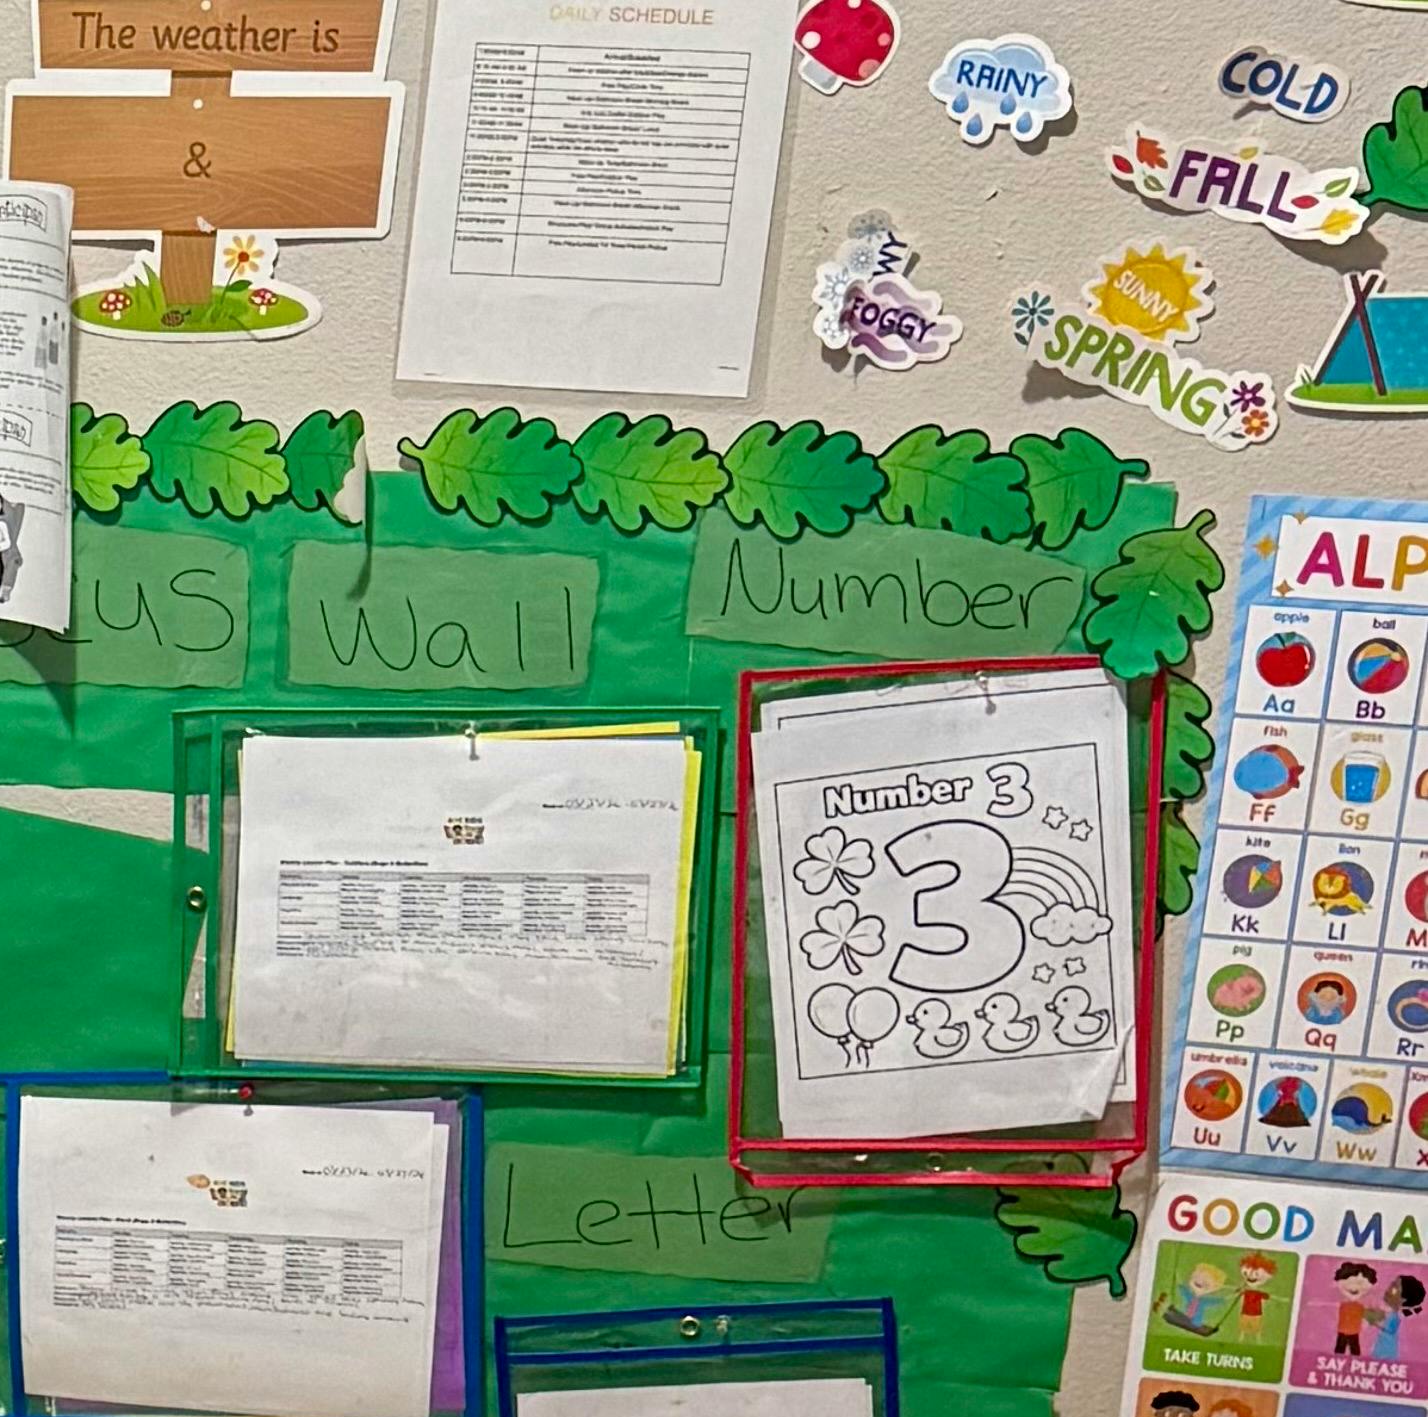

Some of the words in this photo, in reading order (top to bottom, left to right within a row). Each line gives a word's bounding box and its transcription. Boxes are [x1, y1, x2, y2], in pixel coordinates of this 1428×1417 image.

[549, 5, 603, 22] DAILY
[609, 7, 714, 25] SCHEDULE
[72, 12, 136, 54] The
[150, 14, 297, 56] weather
[312, 20, 340, 55] is
[956, 59, 1049, 100] RAINY
[1221, 51, 1340, 116] COLD
[182, 140, 213, 179] &
[1169, 149, 1298, 223] FALL
[1112, 268, 1177, 321] SUNNY
[849, 298, 936, 344] FOGGY
[1044, 314, 1229, 427] SPRING
[1295, 530, 1428, 592] ALP
[720, 536, 1075, 632] Number
[322, 585, 576, 673] Wall
[1273, 610, 1311, 625] apple
[1372, 617, 1397, 631] ball
[1262, 694, 1296, 715] Aa
[1355, 699, 1387, 720] Bb
[823, 774, 972, 818] Number
[986, 761, 1034, 818] 3
[1248, 802, 1278, 824] Ff
[1339, 807, 1371, 830] Gg
[884, 819, 1027, 993] 3
[1230, 913, 1260, 934] Kk
[1405, 928, 1428, 950] M
[1215, 1021, 1246, 1043] Pp
[1304, 1028, 1337, 1051] Qq
[1396, 1037, 1425, 1058] Rr
[1193, 1127, 1222, 1147] Uu
[1266, 1135, 1297, 1155] Vv
[1335, 1141, 1378, 1162] Ww
[503, 1163, 807, 1251] Letter
[1166, 1194, 1315, 1245] GOOD
[1336, 1209, 1428, 1256] MA
[1163, 1348, 1201, 1366] TAKE
[1206, 1351, 1254, 1371] TURNS
[1316, 1355, 1348, 1375] SAY
[1352, 1360, 1409, 1380] PLEASE
[1307, 1370, 1319, 1384] &
[1324, 1372, 1379, 1391] THANK
[1382, 1377, 1415, 1395] YOU
